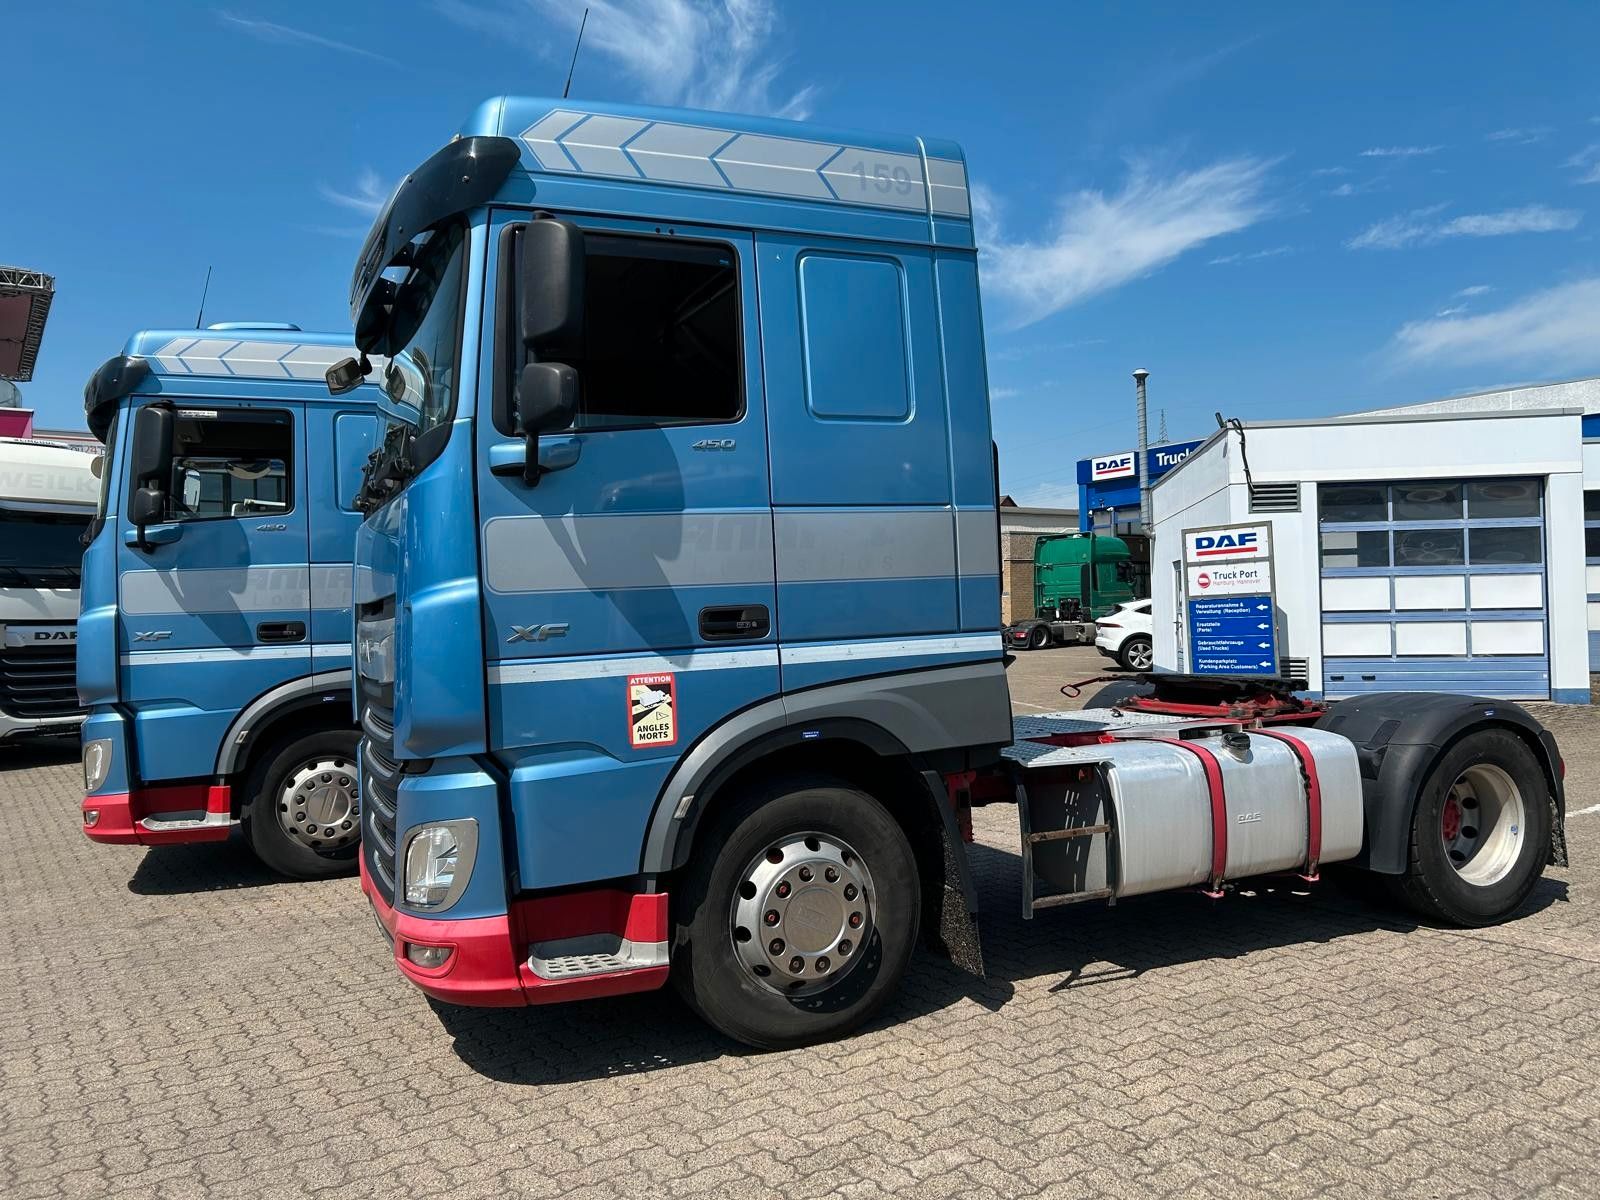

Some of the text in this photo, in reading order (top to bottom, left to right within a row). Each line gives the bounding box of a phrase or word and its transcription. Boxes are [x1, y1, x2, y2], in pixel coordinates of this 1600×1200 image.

[851, 161, 912, 195] 159
[692, 439, 736, 449] 450
[1095, 458, 1131, 471] DAF
[1195, 533, 1257, 550] DAF
[1213, 570, 1258, 580] Truck Port
[132, 631, 173, 642] XF
[506, 623, 569, 642] XF
[630, 675, 672, 685] ATTENTION
[637, 723, 670, 733] ANGLES
[639, 731, 669, 741] MORTS
